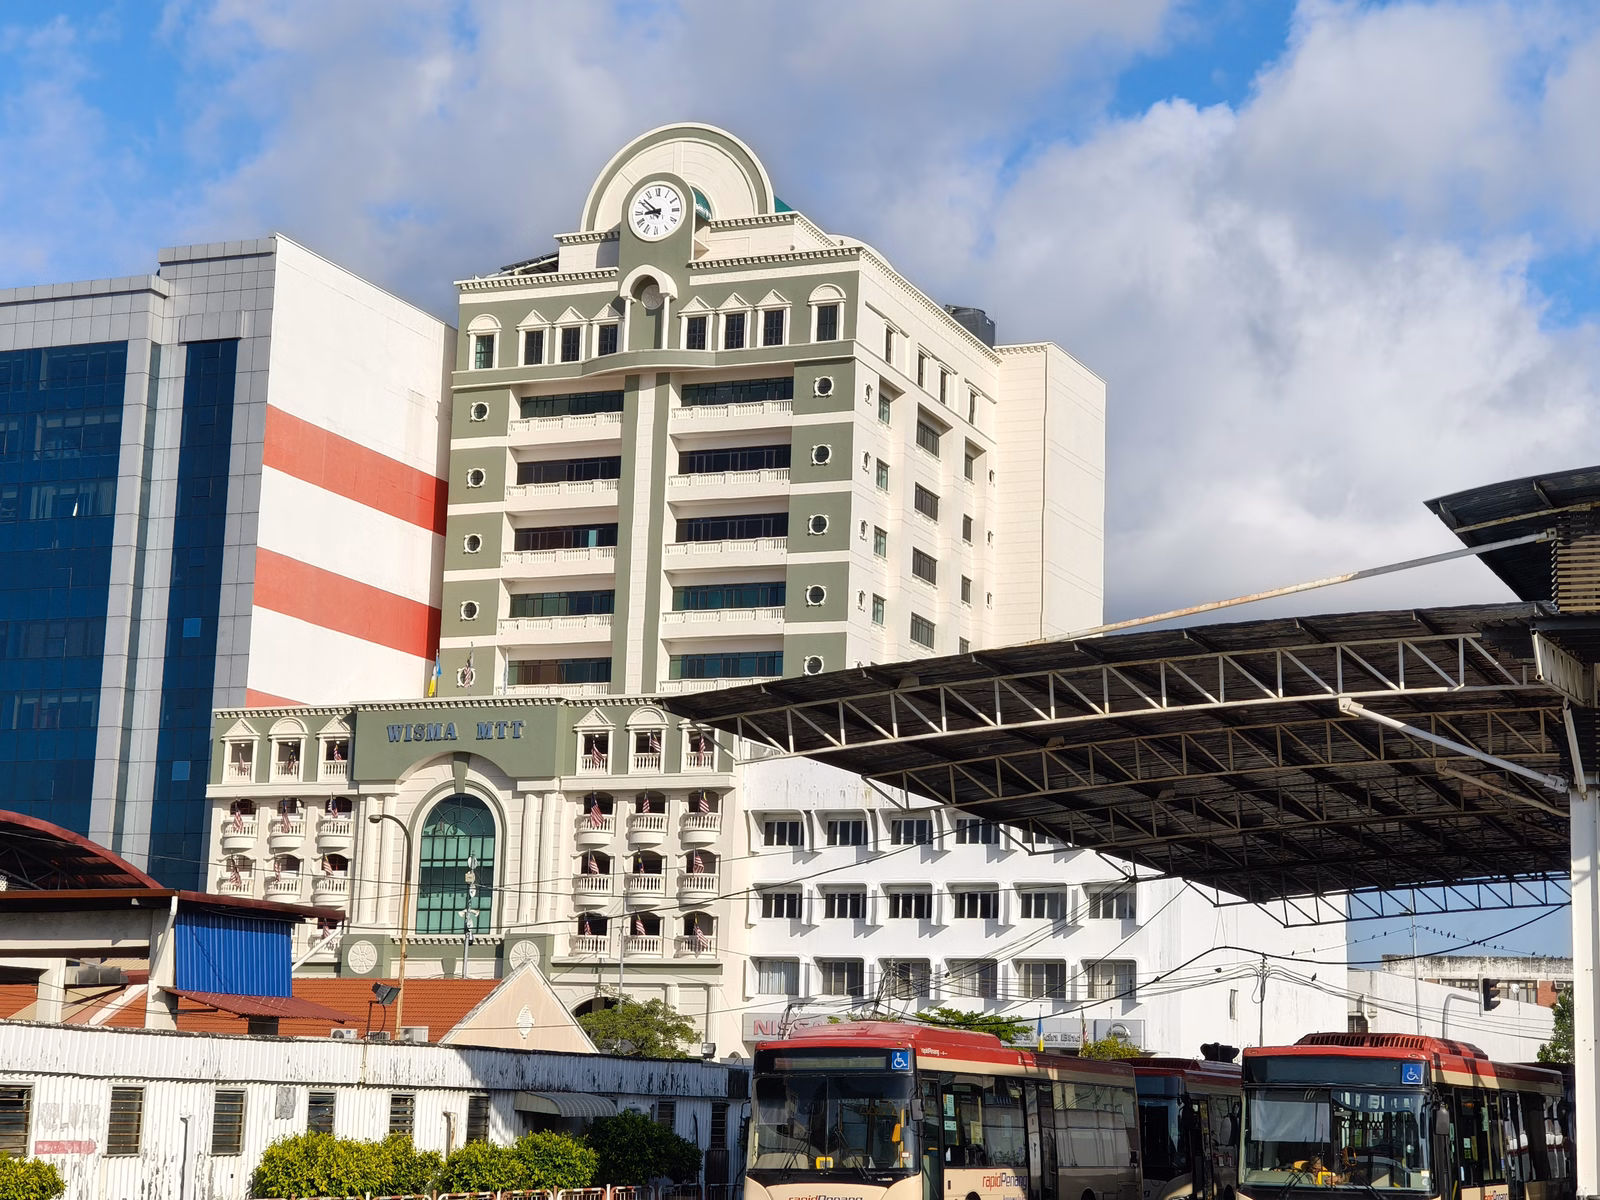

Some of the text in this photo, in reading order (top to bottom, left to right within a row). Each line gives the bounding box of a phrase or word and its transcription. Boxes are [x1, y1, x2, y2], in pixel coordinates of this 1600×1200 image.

[387, 720, 525, 742] WISMA MTT
[982, 1172, 1028, 1191] rapidPenang
